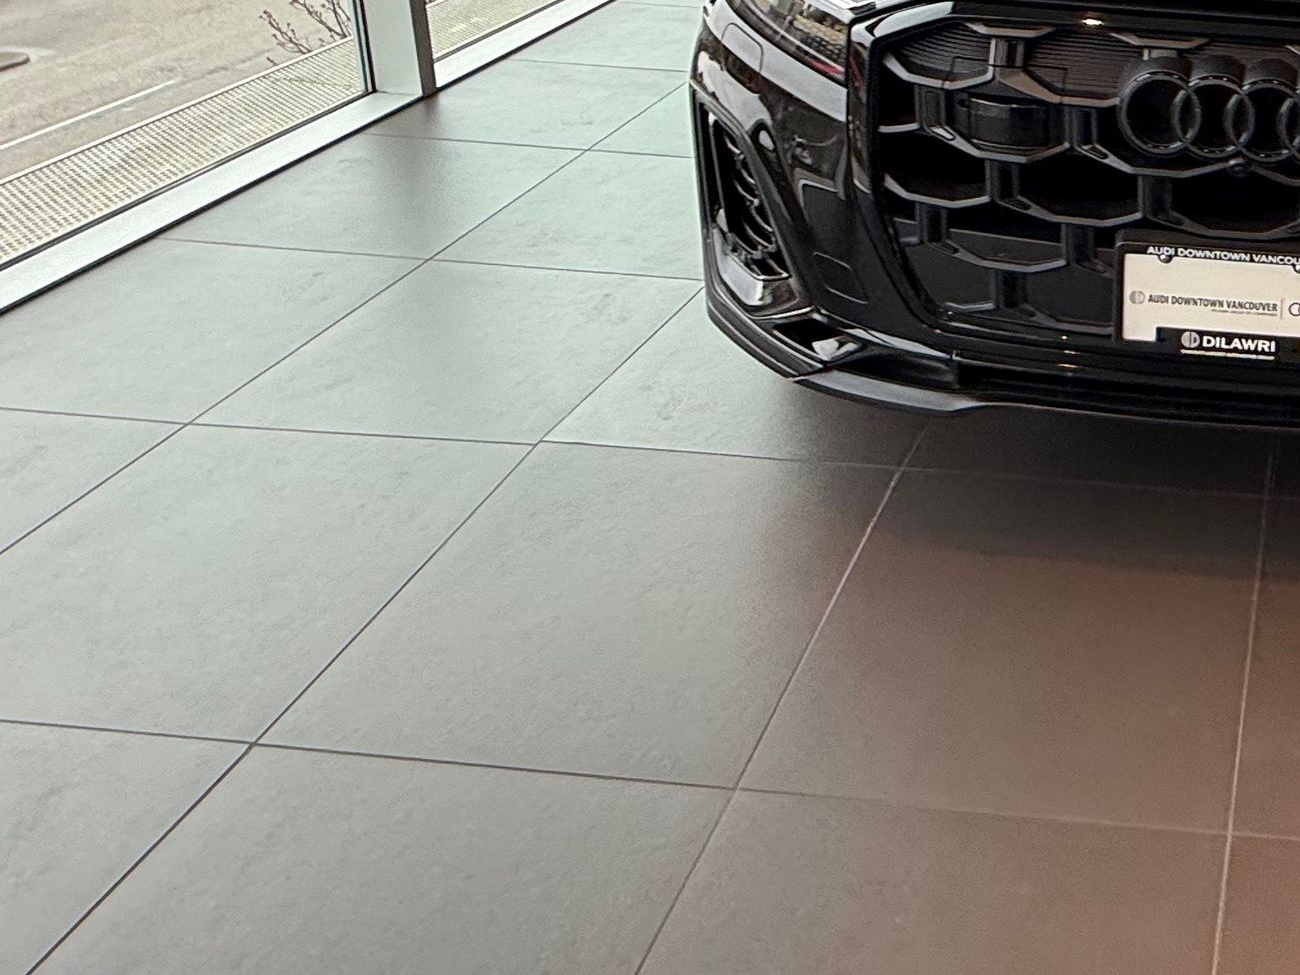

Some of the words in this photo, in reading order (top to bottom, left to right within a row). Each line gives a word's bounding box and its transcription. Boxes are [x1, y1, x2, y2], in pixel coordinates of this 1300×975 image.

[1147, 246, 1175, 256] AUDI
[1177, 248, 1250, 261] DOWNTOWN
[1148, 294, 1169, 304] AUDI
[1171, 295, 1224, 308] DOWNTOWN
[1226, 300, 1278, 312] VANCOUVER
[1202, 335, 1276, 352] DILAWRI
